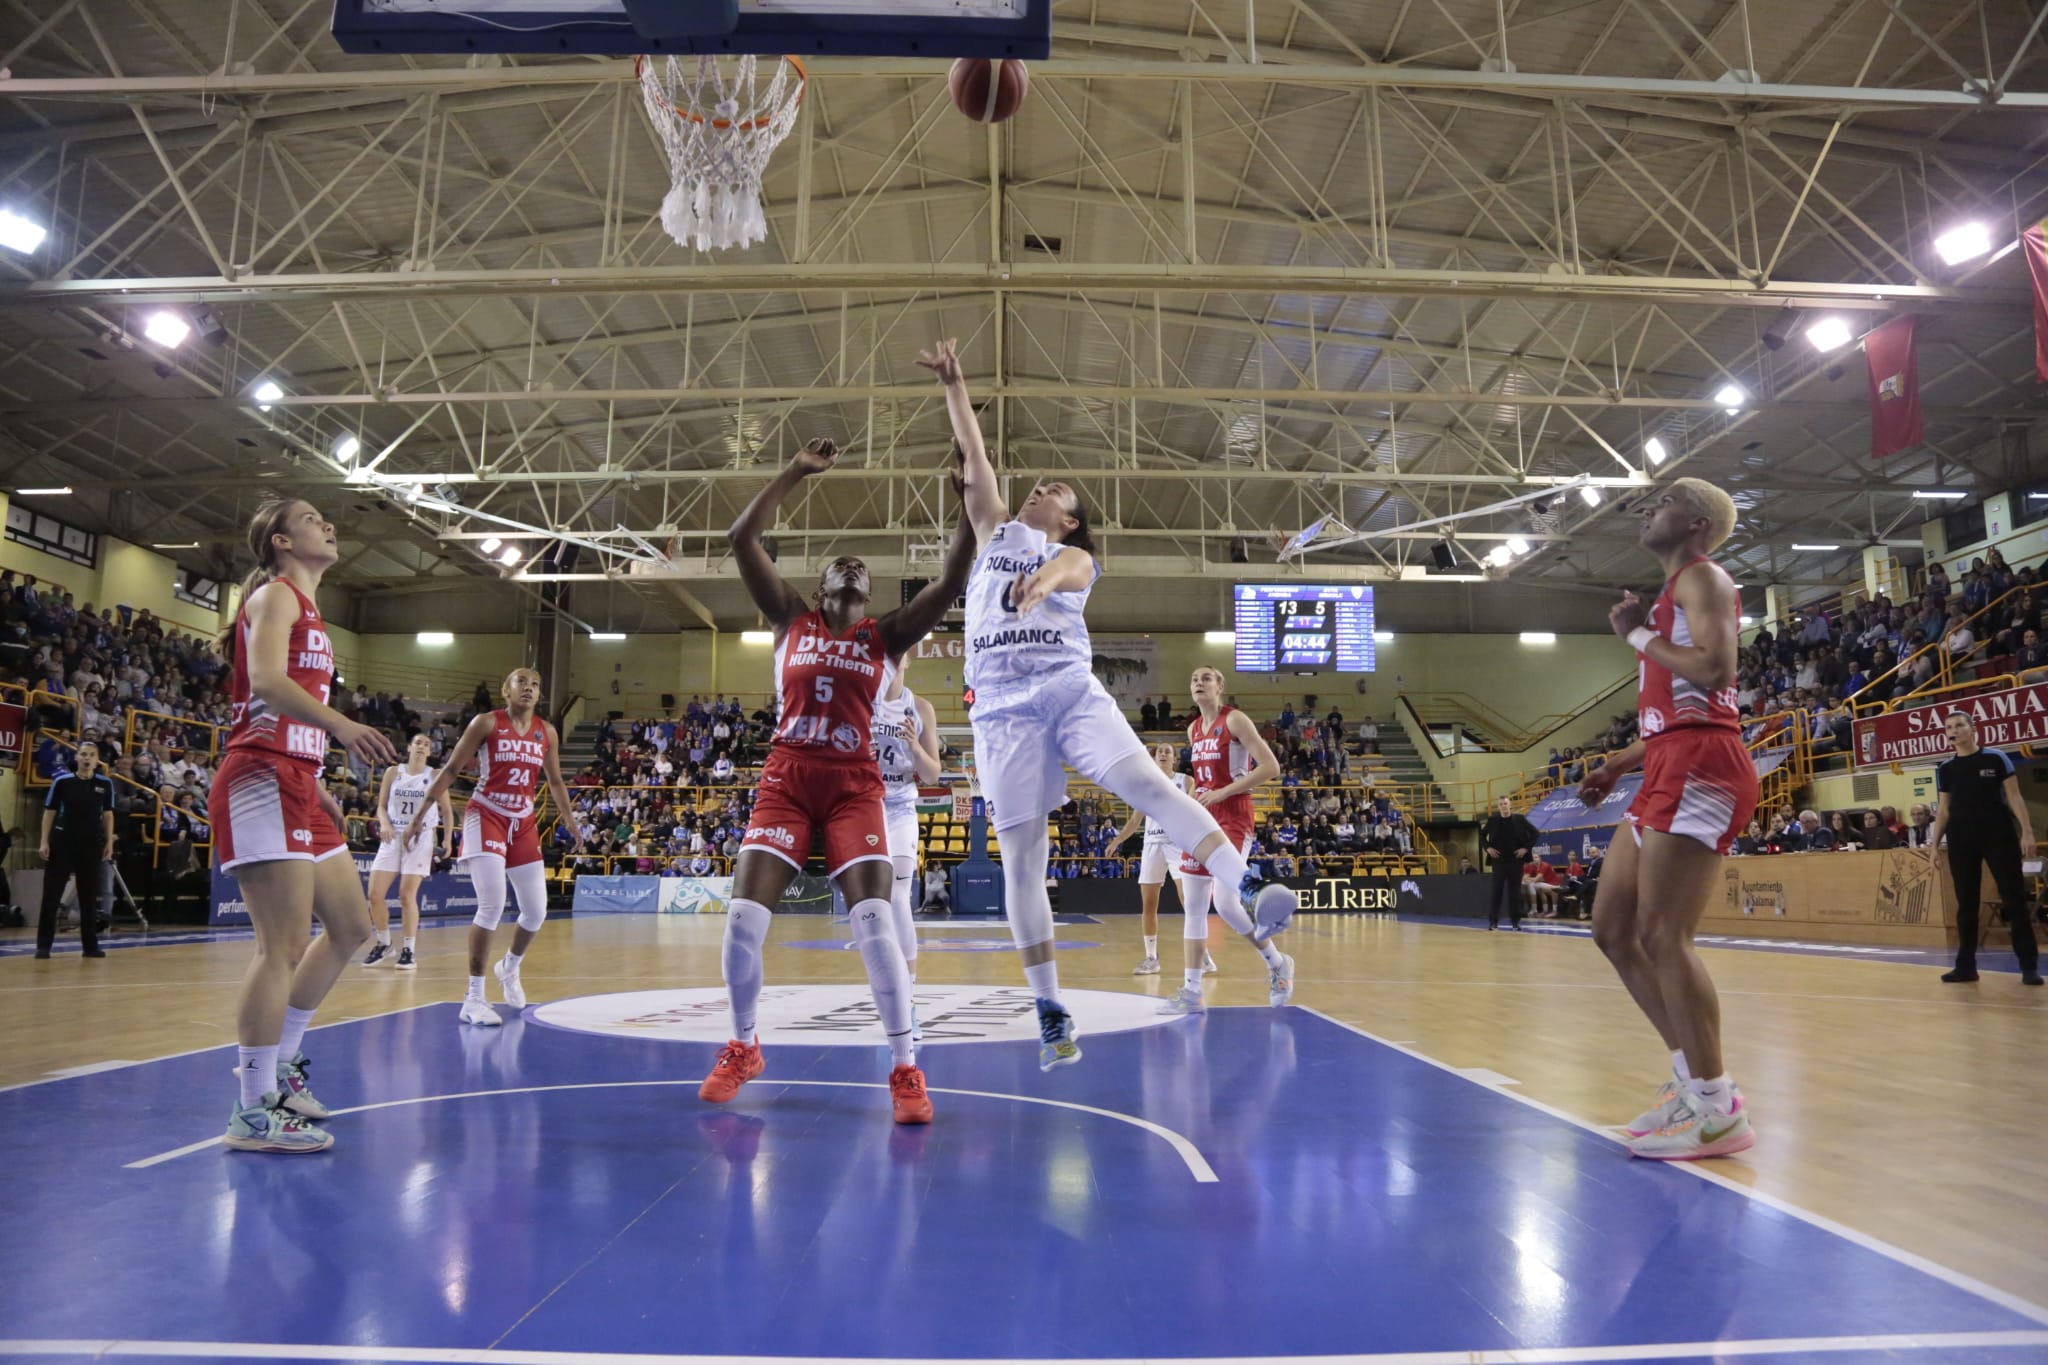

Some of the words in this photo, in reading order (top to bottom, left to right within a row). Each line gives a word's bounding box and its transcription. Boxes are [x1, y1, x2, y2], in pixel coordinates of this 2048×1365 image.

[1279, 601, 1298, 615] 13
[1315, 601, 1326, 615] 5
[307, 629, 334, 657] DV
[797, 635, 872, 661] DVTK
[973, 629, 1064, 653] SALAMANCA
[1283, 634, 1327, 649] 04:44
[788, 652, 875, 678] HUN-Therm
[815, 675, 834, 703] 5
[963, 690, 975, 704] 4
[1908, 688, 2047, 734] SAAMA
[1984, 723, 2009, 745] DE
[2014, 718, 2038, 739] LA
[497, 739, 545, 757] DVTK
[494, 752, 545, 767] HUN-Therm
[507, 767, 532, 787] 24
[1196, 765, 1213, 782] 14
[401, 801, 415, 815] 21
[745, 826, 795, 845] apollo
